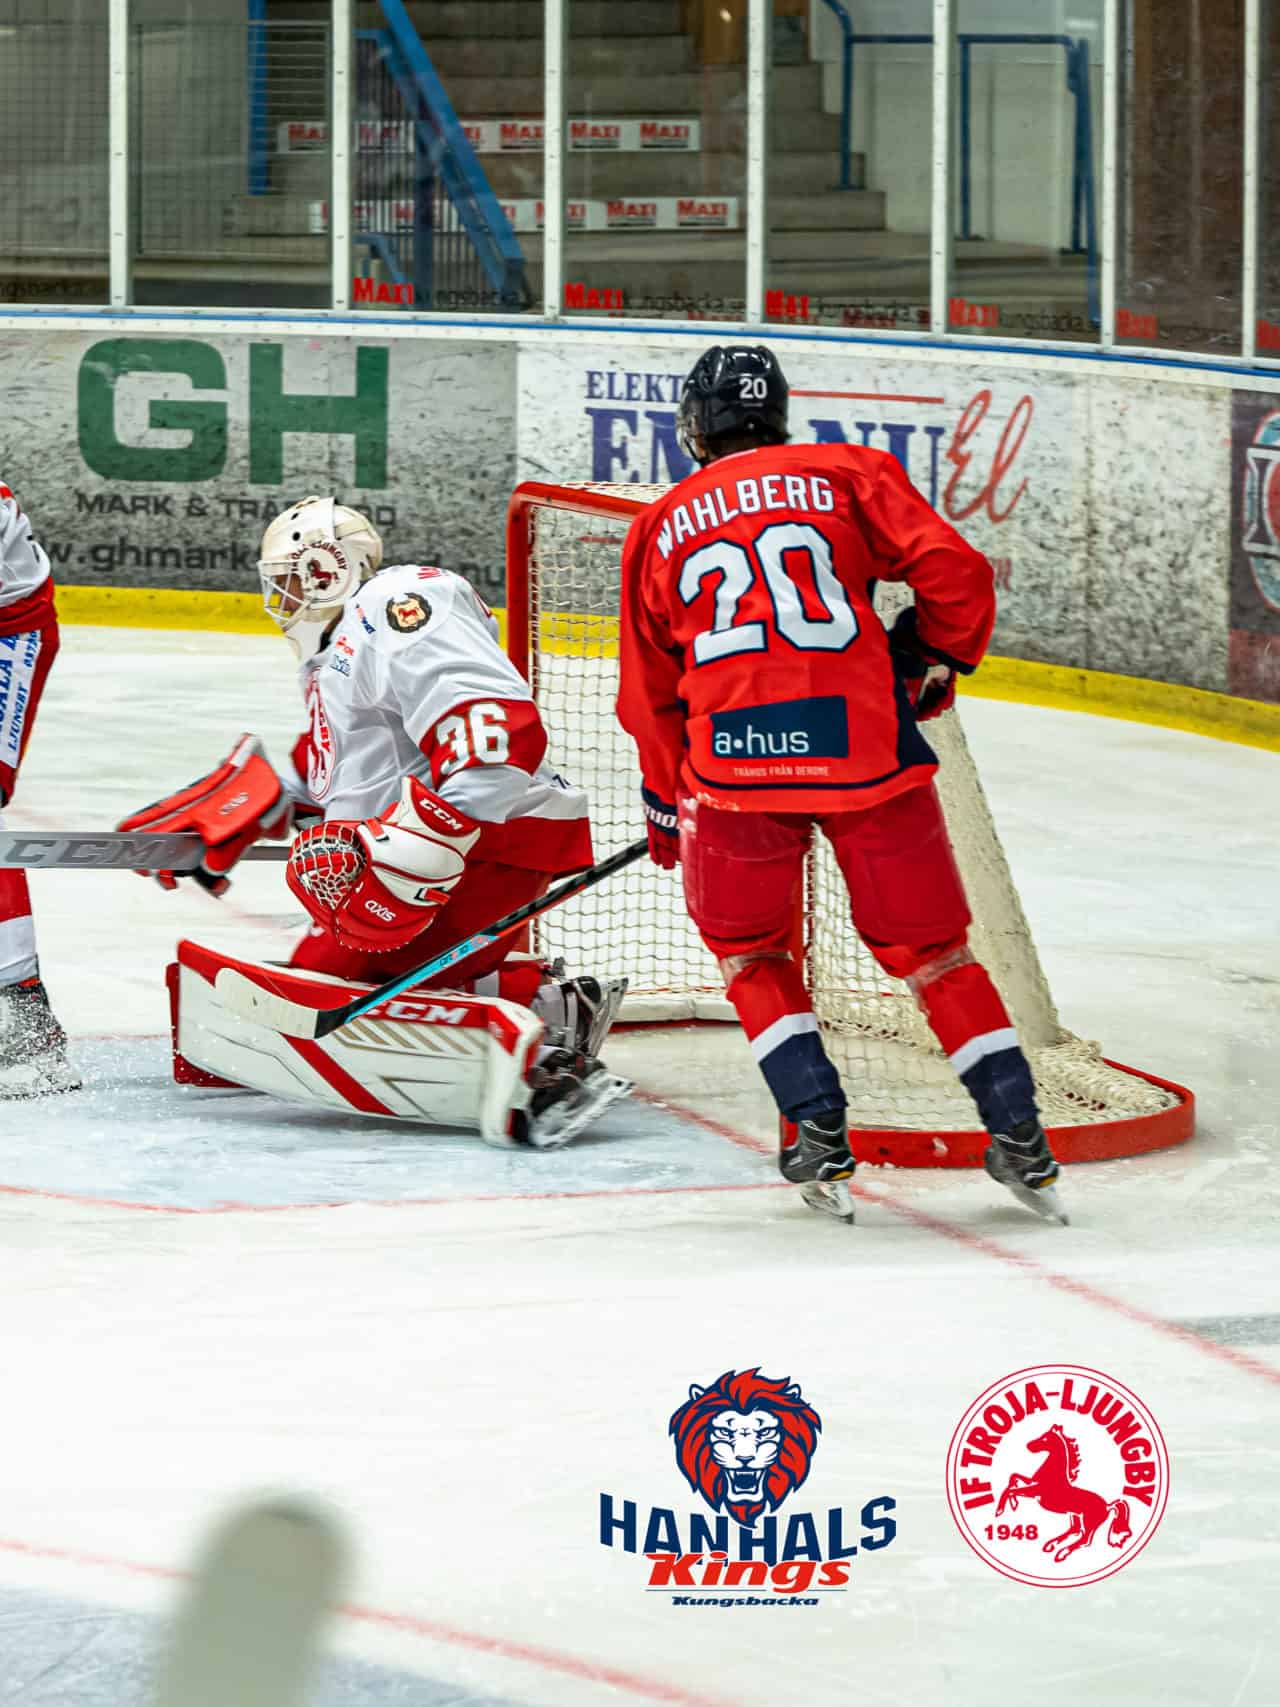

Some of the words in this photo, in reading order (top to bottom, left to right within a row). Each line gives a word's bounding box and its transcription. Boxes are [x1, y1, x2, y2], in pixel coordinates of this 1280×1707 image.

[640, 122, 688, 138] MAXI
[677, 201, 728, 217] MAXI
[586, 370, 684, 402] ELEKT
[739, 376, 768, 400] 20
[77, 338, 389, 489] GH
[76, 492, 173, 517] MARK
[186, 492, 209, 517] &
[655, 474, 835, 560] WAHLBERG
[677, 521, 860, 667] 20
[436, 702, 510, 775] 36
[420, 797, 464, 831] CCM
[5, 839, 166, 864] CCM
[350, 995, 469, 1025] CM
